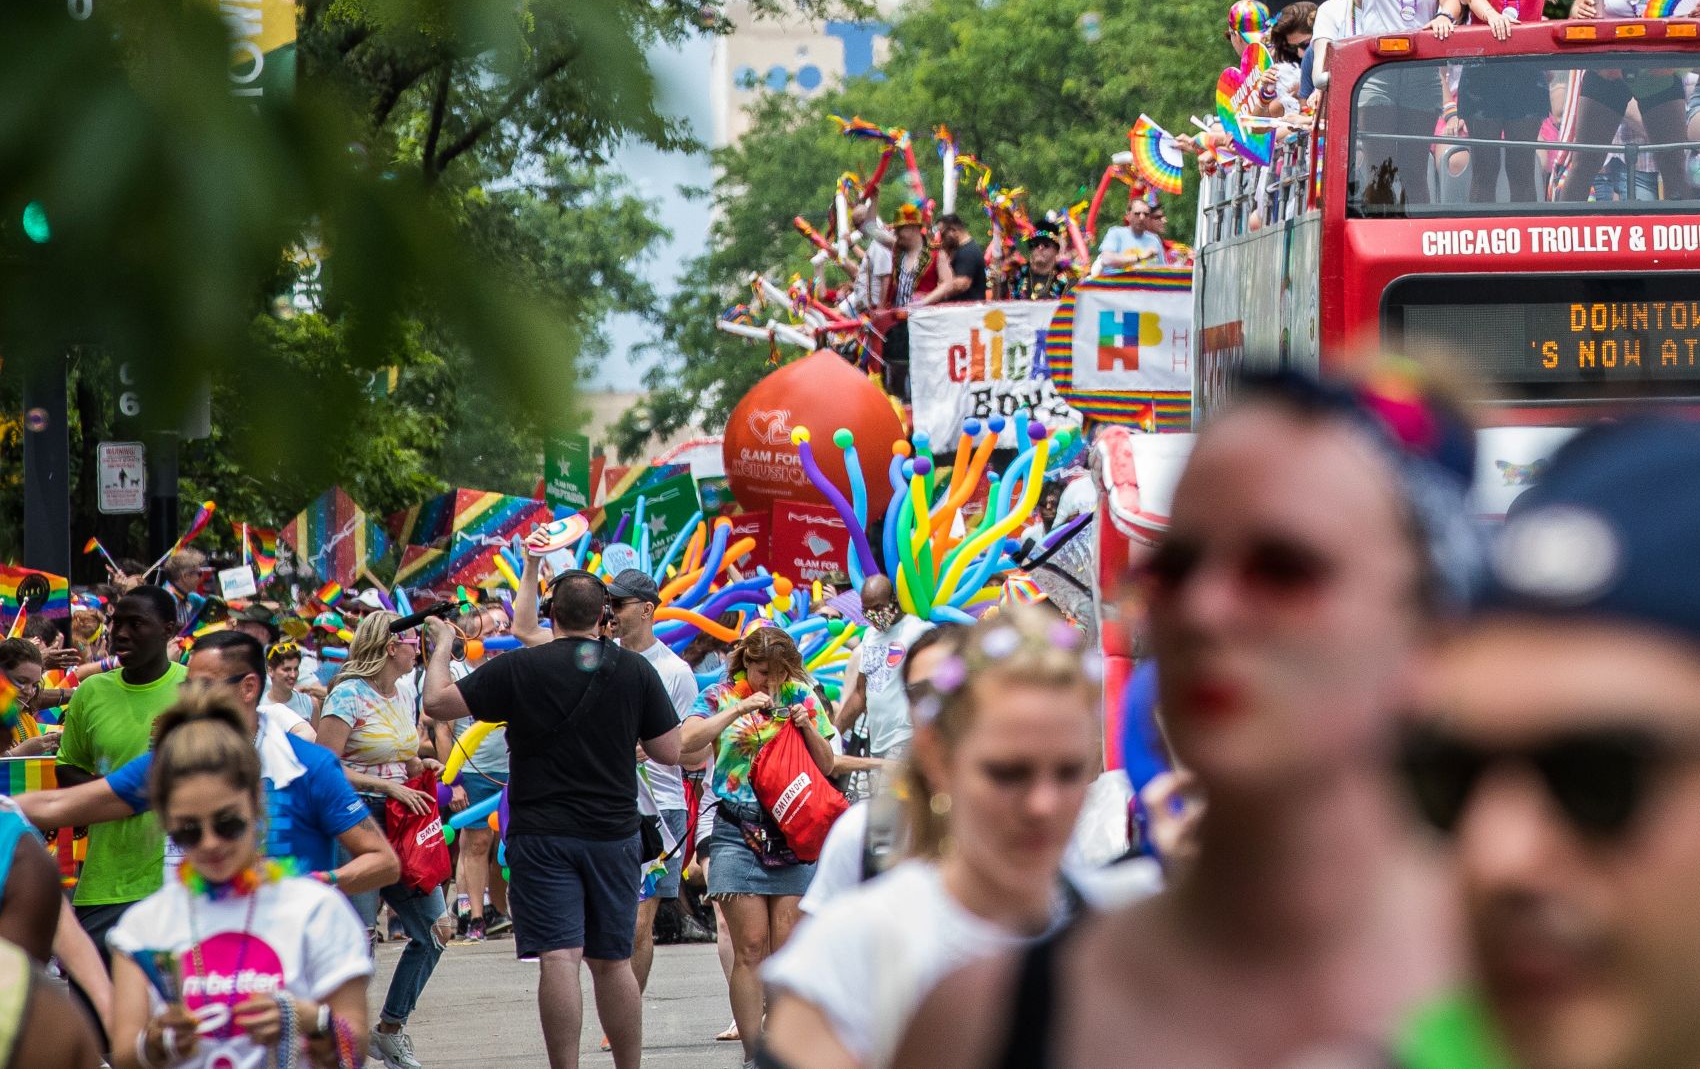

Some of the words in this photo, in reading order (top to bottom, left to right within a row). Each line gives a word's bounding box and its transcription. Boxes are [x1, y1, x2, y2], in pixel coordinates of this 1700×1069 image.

[1422, 228, 1520, 256] CHICAGO
[1527, 226, 1622, 253] TROLLEY
[1629, 226, 1646, 252] &
[1579, 339, 1641, 368] NOW
[1661, 338, 1698, 366] AT
[740, 448, 772, 463] GLAM
[774, 775, 807, 817] SMIRNOFF
